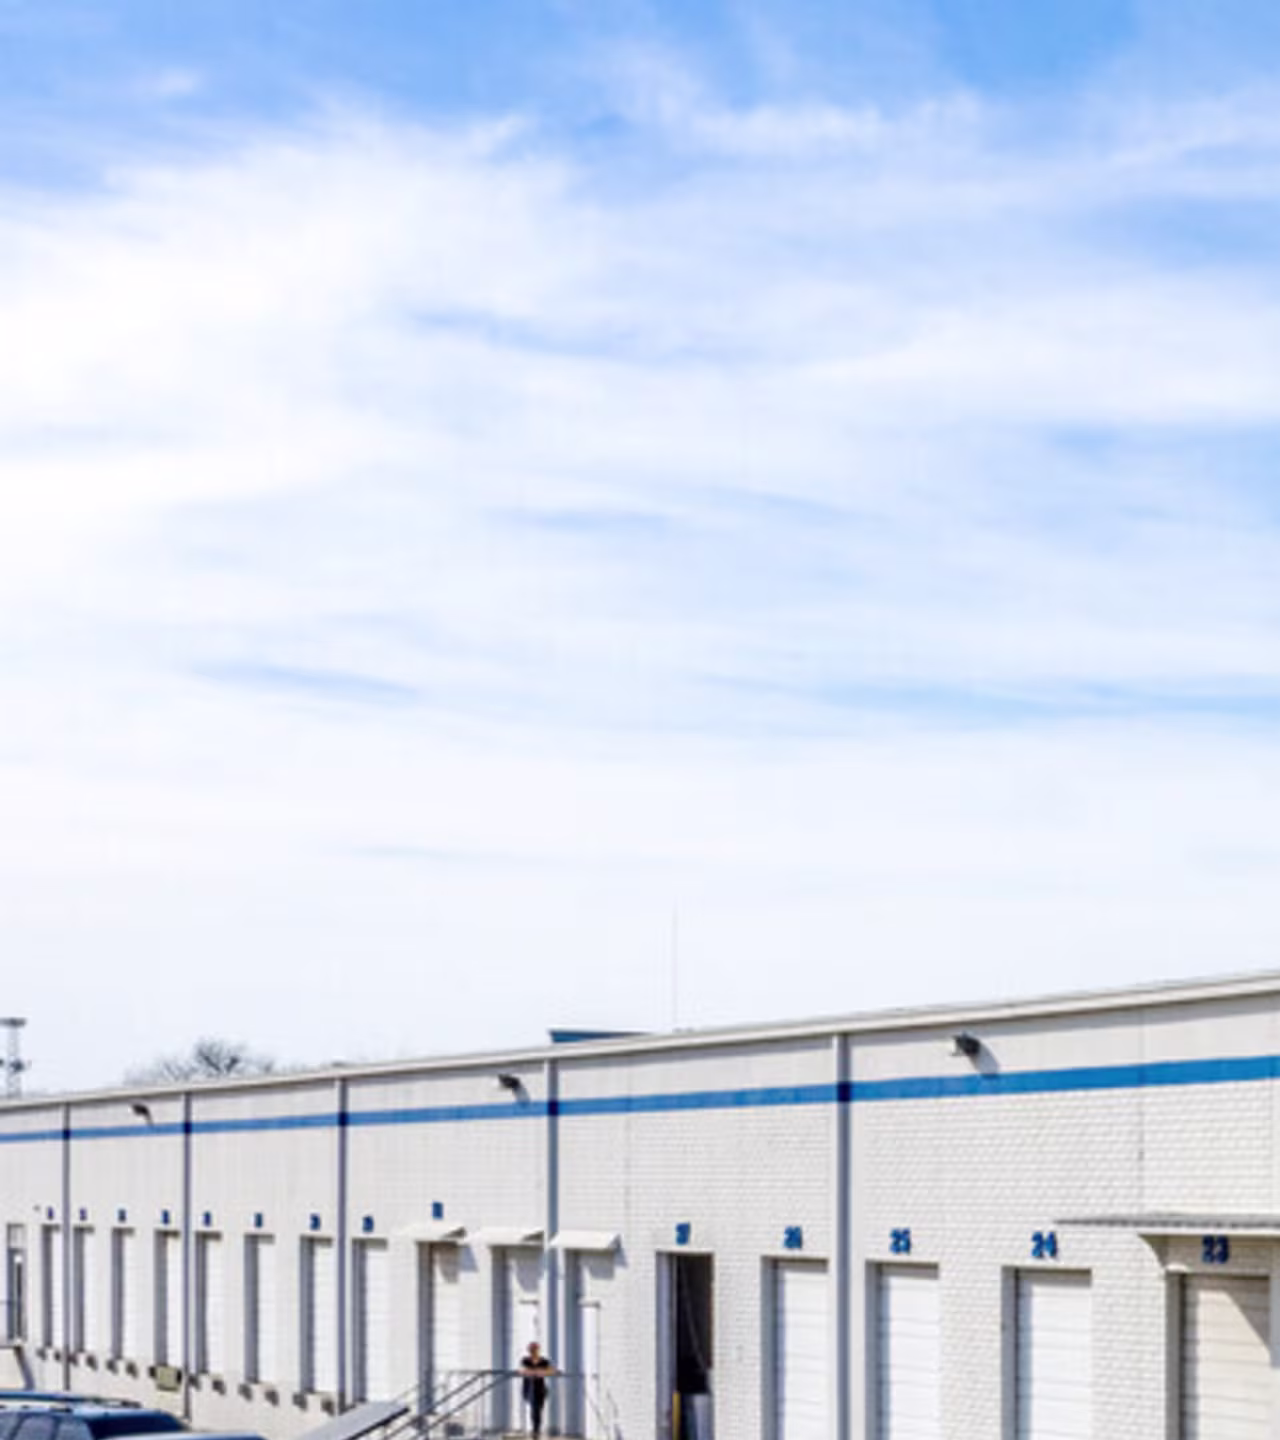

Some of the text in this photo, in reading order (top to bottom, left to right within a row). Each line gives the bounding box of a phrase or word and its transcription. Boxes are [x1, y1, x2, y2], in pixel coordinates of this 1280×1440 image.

[889, 1228, 912, 1255] 25
[1031, 1231, 1058, 1258] 24
[1202, 1235, 1230, 1263] 23
